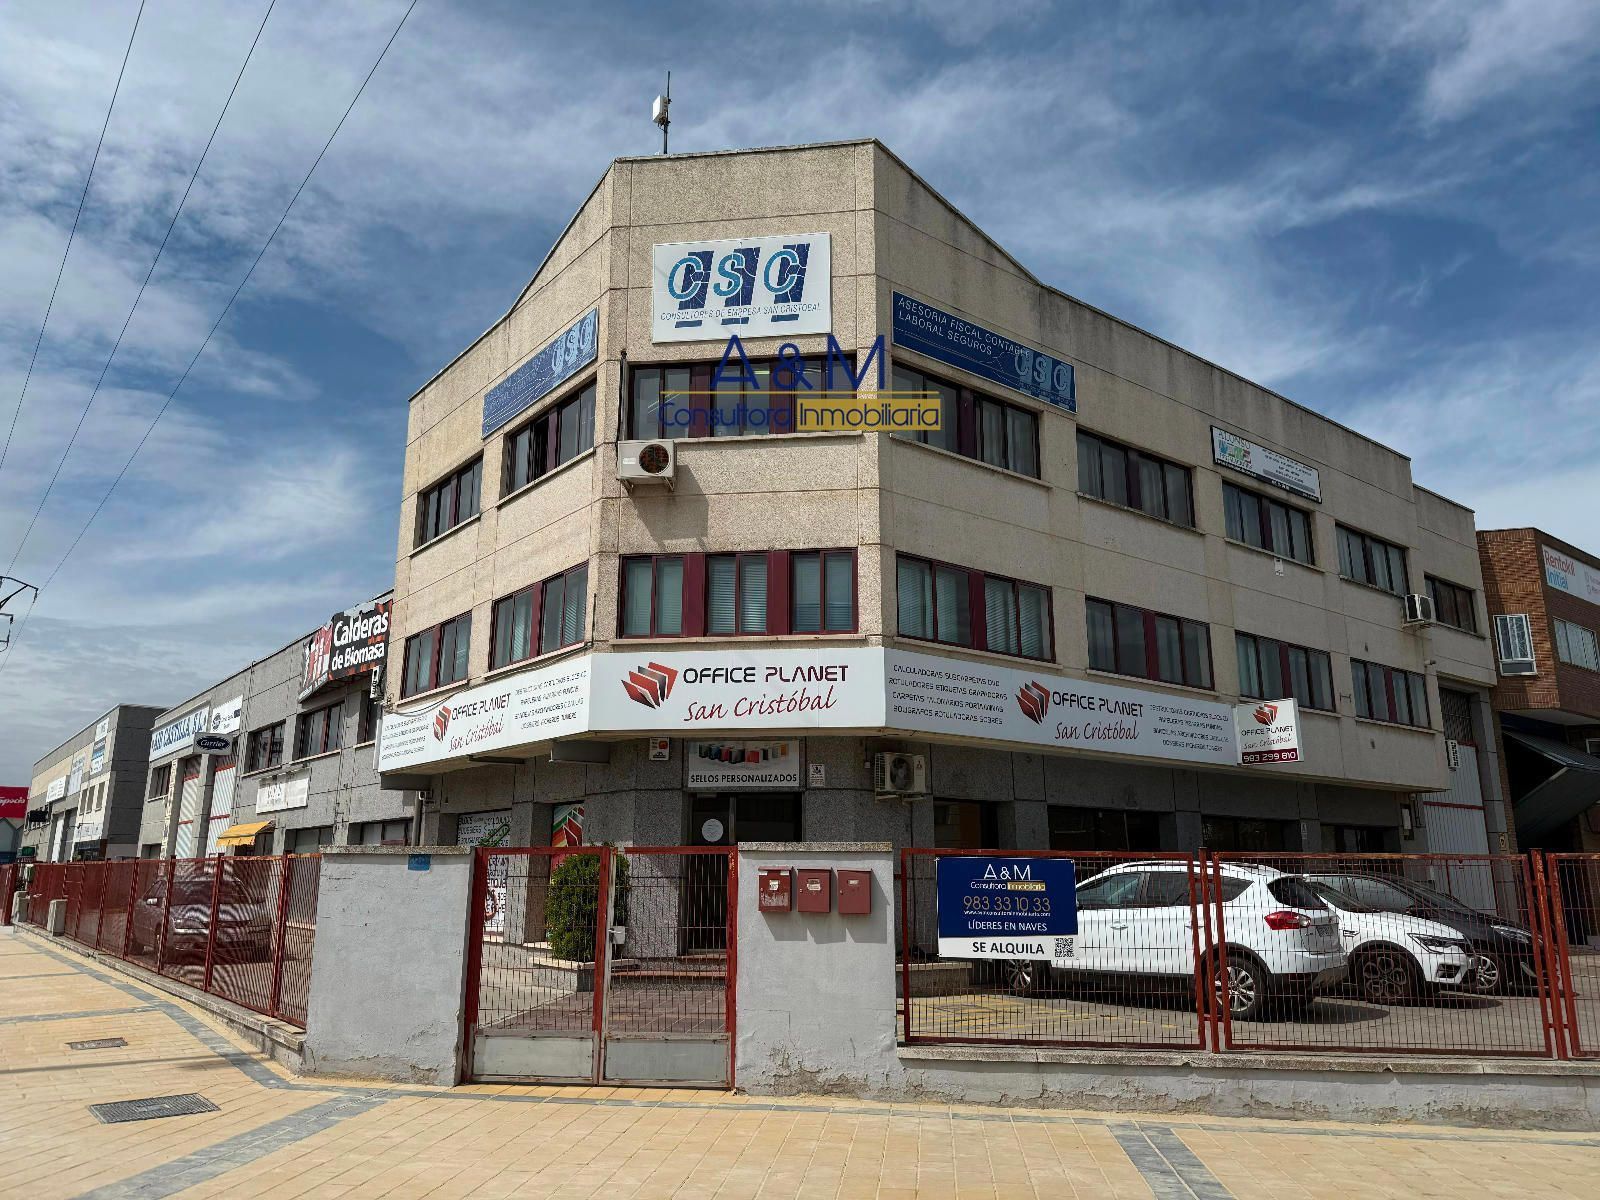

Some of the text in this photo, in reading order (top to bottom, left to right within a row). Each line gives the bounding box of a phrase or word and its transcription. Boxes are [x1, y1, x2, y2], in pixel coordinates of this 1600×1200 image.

[668, 249, 800, 301] CSC
[660, 310, 714, 322] CONSULTORES
[716, 309, 726, 319] DE
[727, 307, 762, 318] EMPRESA
[763, 305, 779, 315] SAN
[899, 310, 992, 355] LABORAL SEGUROS
[950, 319, 982, 340] FISCAL
[1014, 350, 1069, 391] CSC
[333, 611, 389, 647] Calderas
[331, 642, 385, 671] de Biomasa
[683, 665, 849, 684] OFFICE PLANET
[893, 664, 943, 679] CALCULADORAS
[944, 671, 987, 685] SUBCARPETAS
[888, 677, 1008, 701] ROTULADORES ETIQUETAS GRAPADORAS
[451, 701, 479, 722] OFFICE
[479, 692, 512, 716] PLANET
[683, 685, 838, 722] San Cristóbal
[892, 691, 925, 703] CARPETAS
[926, 696, 964, 708] TALONARIOS
[1052, 691, 1144, 718] OFFICE PLANET
[934, 710, 978, 723] ROTULADORAS
[979, 715, 1003, 725] SOBRES
[1054, 723, 1081, 741] San
[1083, 719, 1140, 741] Cristóbal
[1241, 725, 1293, 737] OFFICE PLANET
[200, 739, 226, 747] Carrier
[448, 731, 465, 753] San
[1243, 742, 1258, 750] San
[1243, 751, 1296, 763] 983 299 810
[690, 773, 719, 784] SELLOS
[721, 773, 797, 784] PERSONALIZADOS
[983, 863, 1031, 881] A & M
[970, 881, 1045, 891] Consultora Inmobiliaria
[963, 895, 1051, 912] 983 33 10 33
[968, 919, 1048, 932] LÍDERES EN NAVES
[972, 941, 1045, 955] SE ALQUILA
